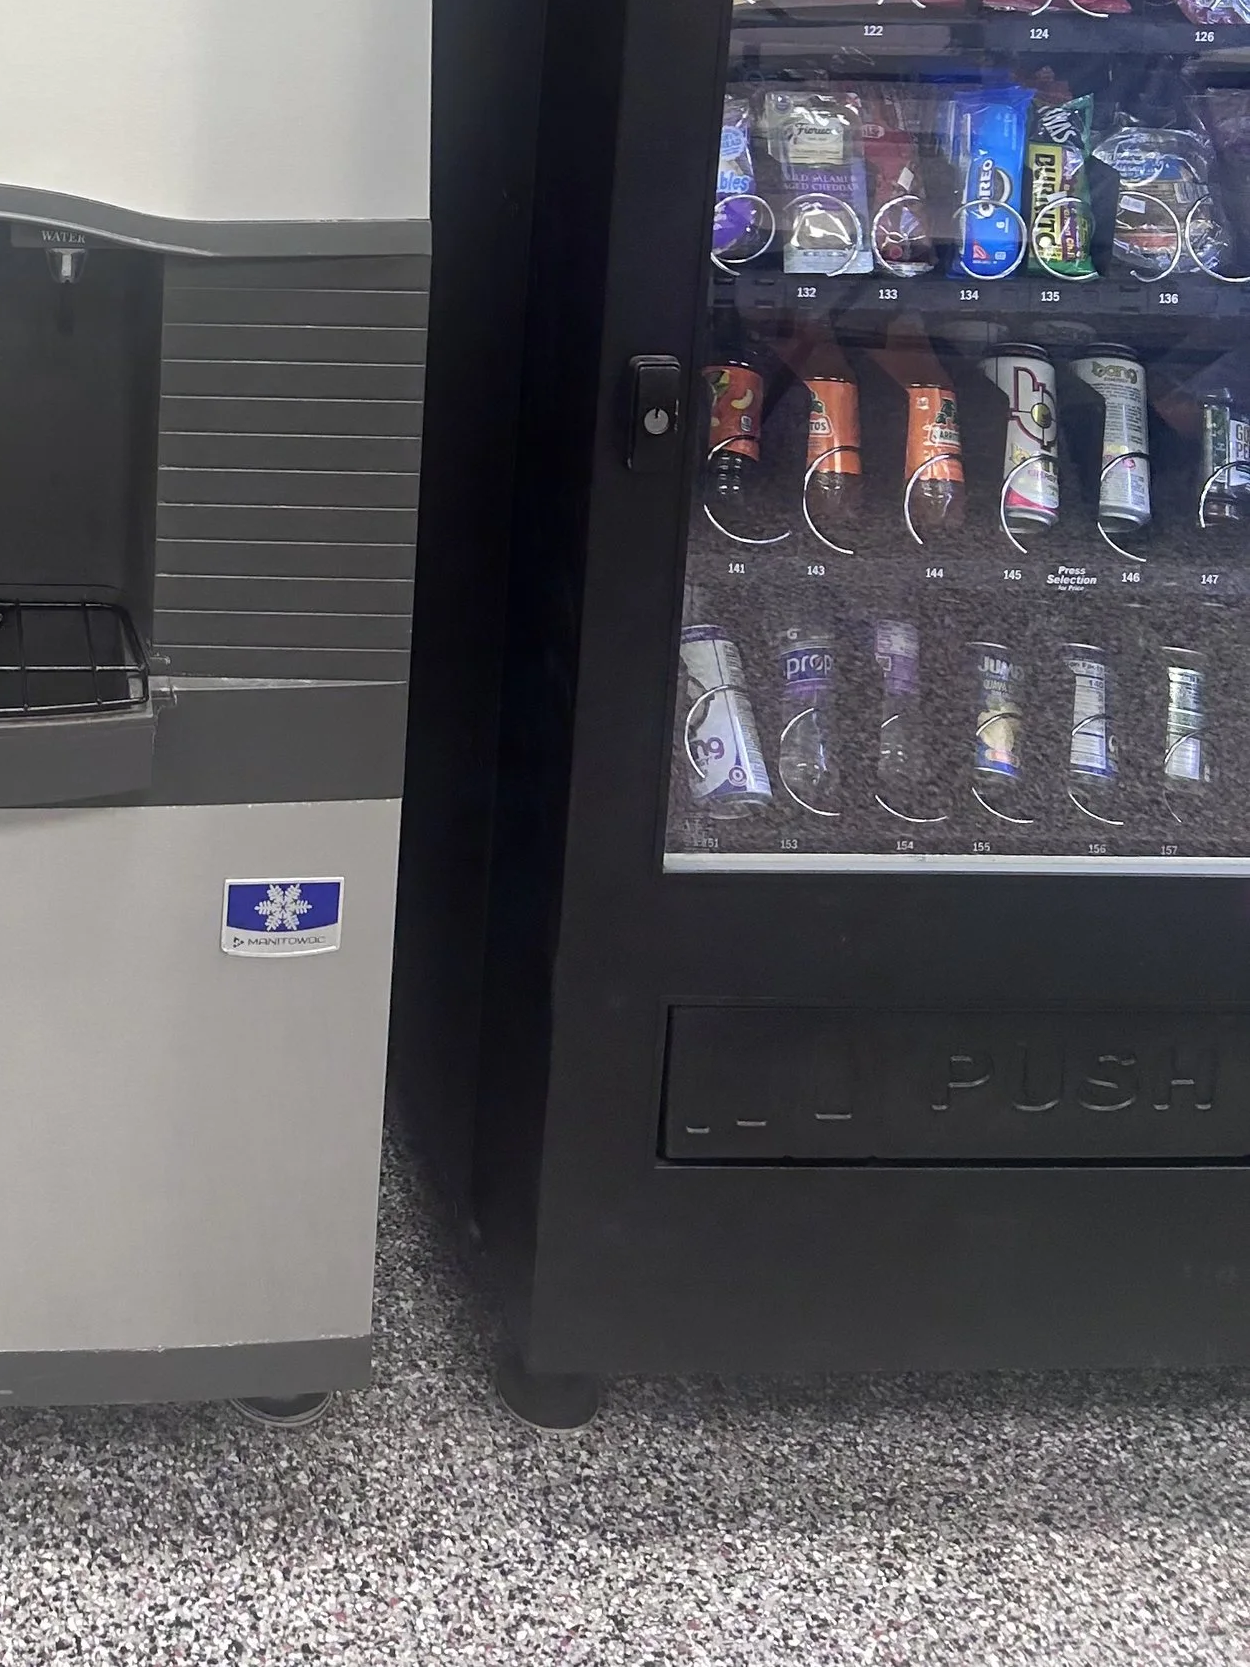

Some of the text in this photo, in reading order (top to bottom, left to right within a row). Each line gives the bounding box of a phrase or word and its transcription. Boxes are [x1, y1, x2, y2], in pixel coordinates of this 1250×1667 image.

[863, 25, 883, 36] 122
[1030, 28, 1049, 40] 124
[1195, 31, 1215, 42] 126
[41, 230, 86, 244] WATER
[797, 287, 816, 298] 132
[878, 289, 898, 300] 133
[960, 290, 979, 301] 134
[1041, 291, 1060, 302] 135
[1159, 293, 1179, 304] 136
[728, 563, 745, 574] 141
[807, 565, 825, 576] 143
[925, 567, 944, 578] 144
[1058, 566, 1086, 575] Press
[1003, 569, 1022, 580] 145
[1046, 575, 1097, 584] Selection
[1121, 572, 1141, 583] 146
[1200, 574, 1219, 584] 147
[780, 839, 798, 849] 153
[896, 841, 915, 850] 154
[973, 842, 991, 852] 155
[1088, 844, 1107, 854] 156
[1160, 845, 1178, 855] 157
[247, 936, 327, 946] MANITOWOC
[930, 1049, 1215, 1112] PUSH
